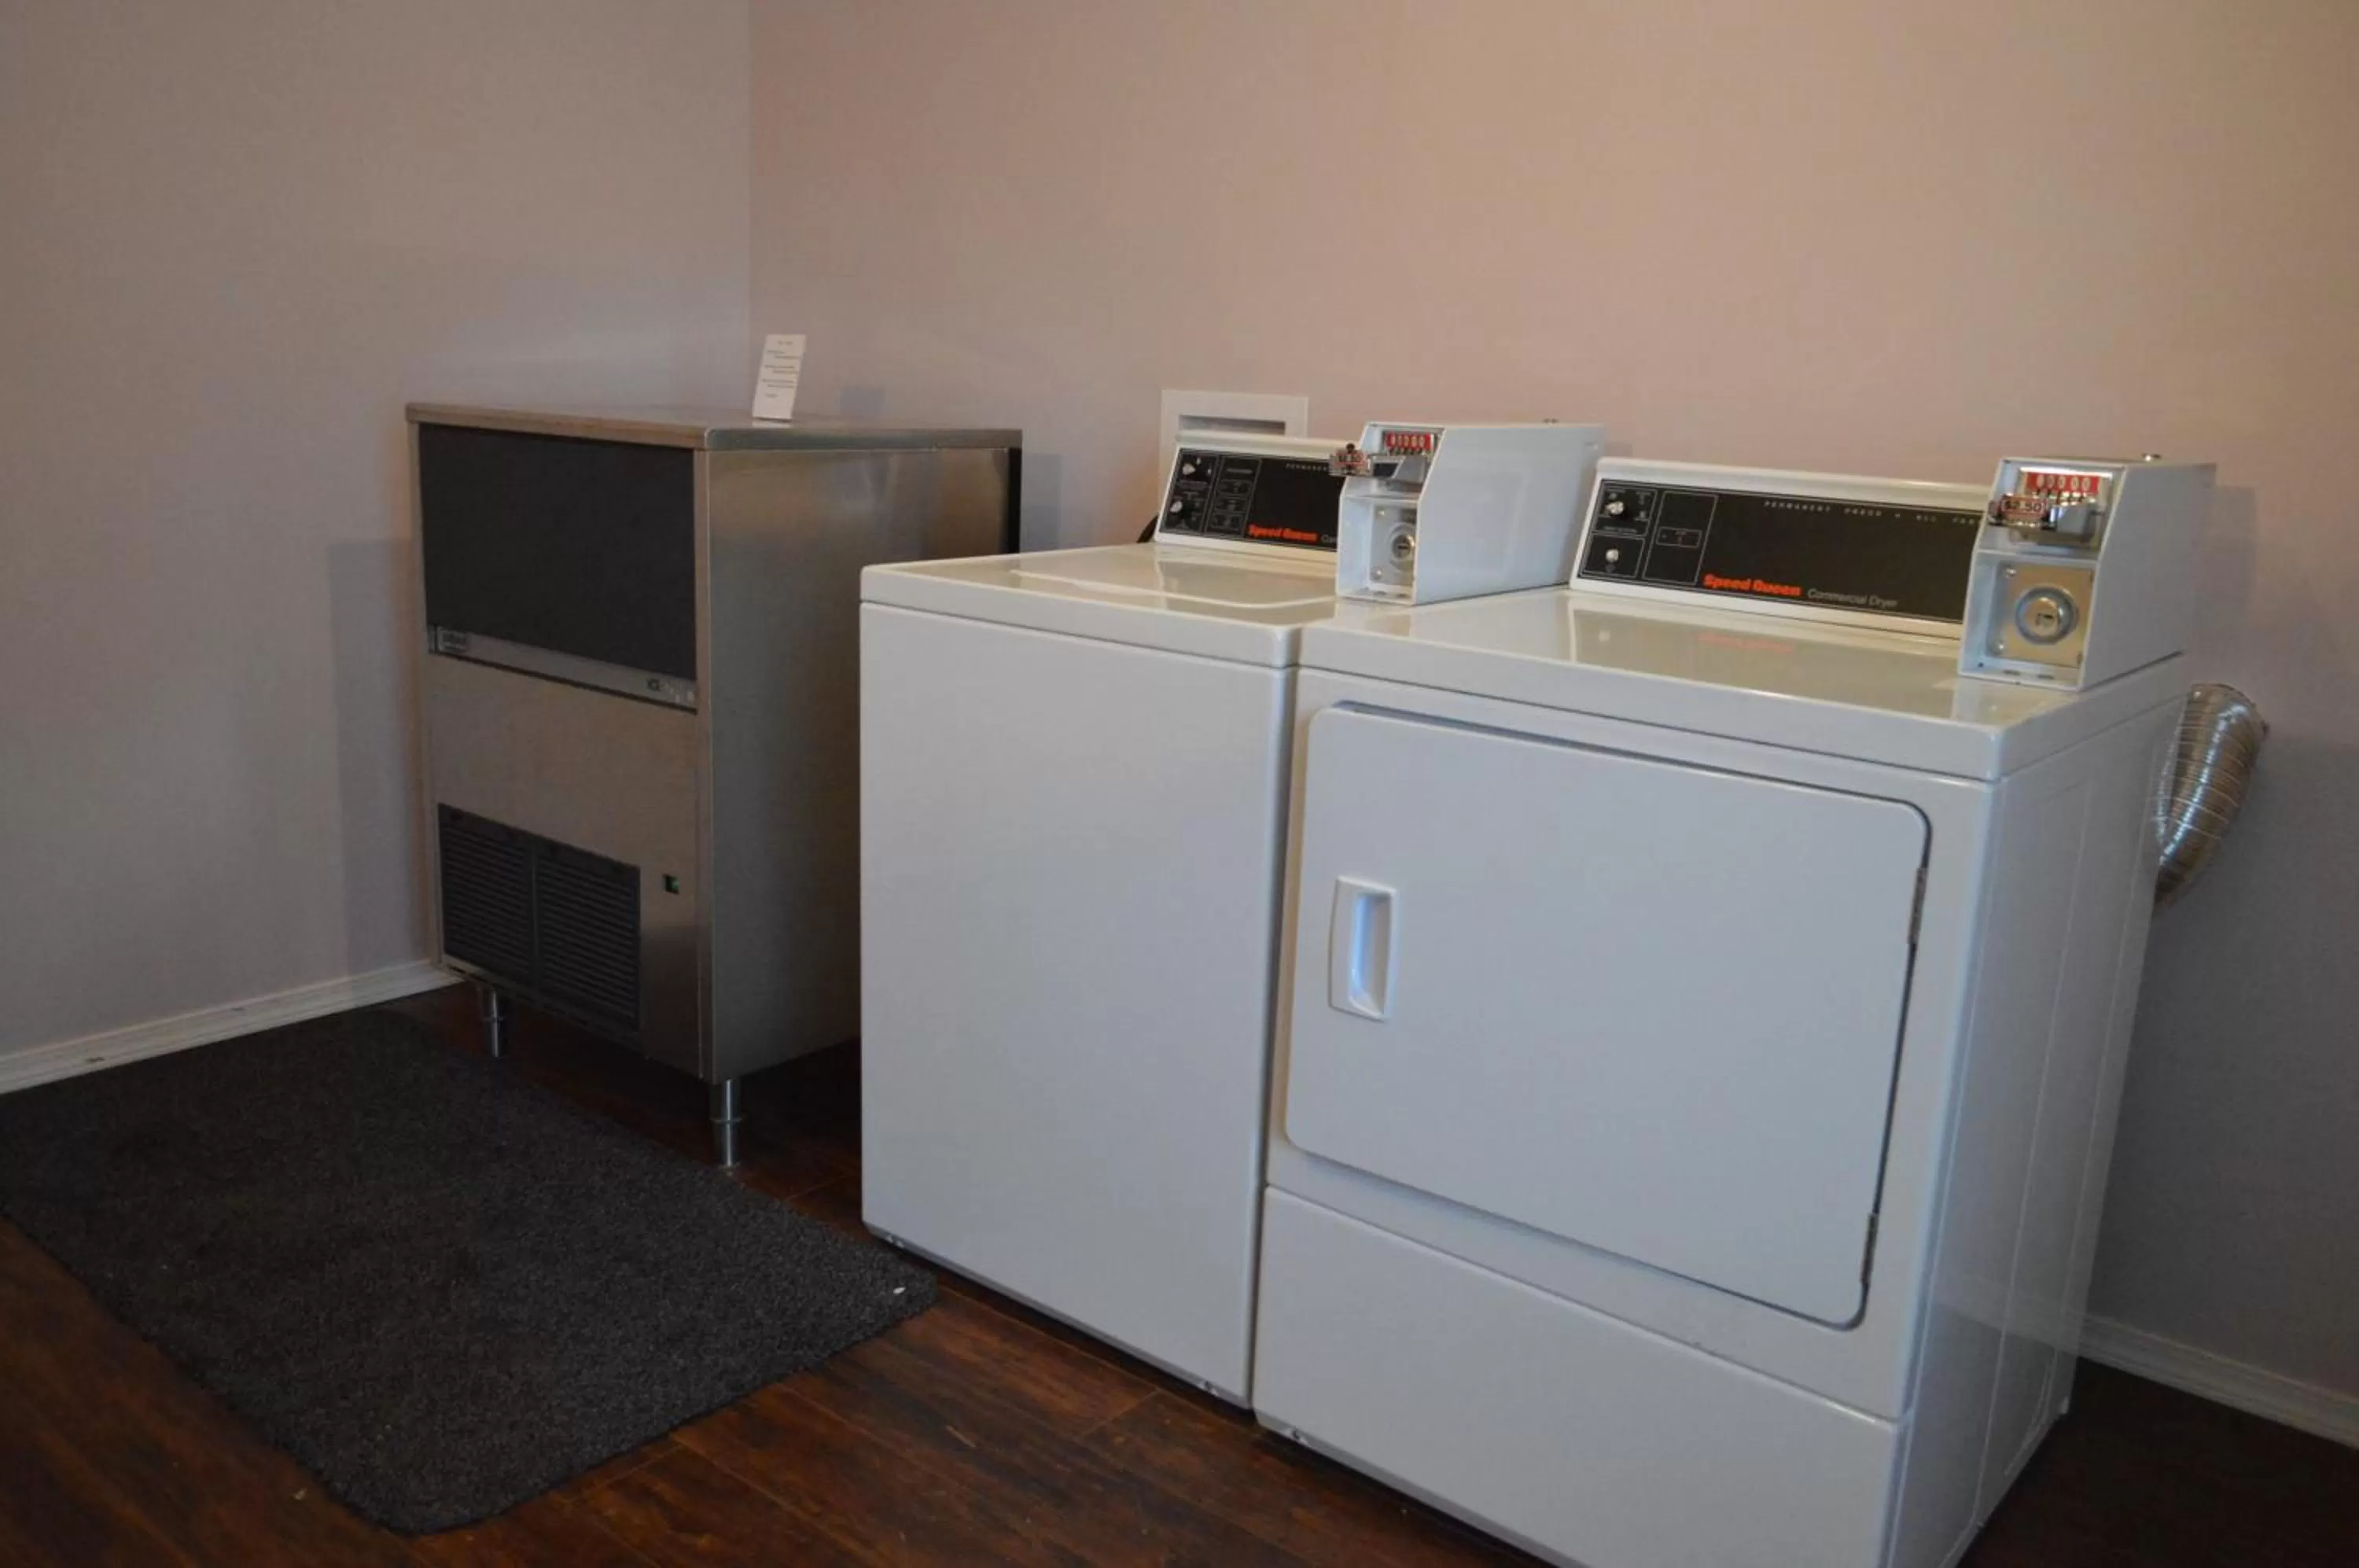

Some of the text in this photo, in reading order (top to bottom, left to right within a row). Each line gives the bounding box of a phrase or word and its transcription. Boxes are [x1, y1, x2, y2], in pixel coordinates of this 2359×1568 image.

[1248, 525, 1282, 539] Speed
[1283, 528, 1318, 543] Queen
[1703, 574, 1898, 609] Speed Queen Commercial Dryer
